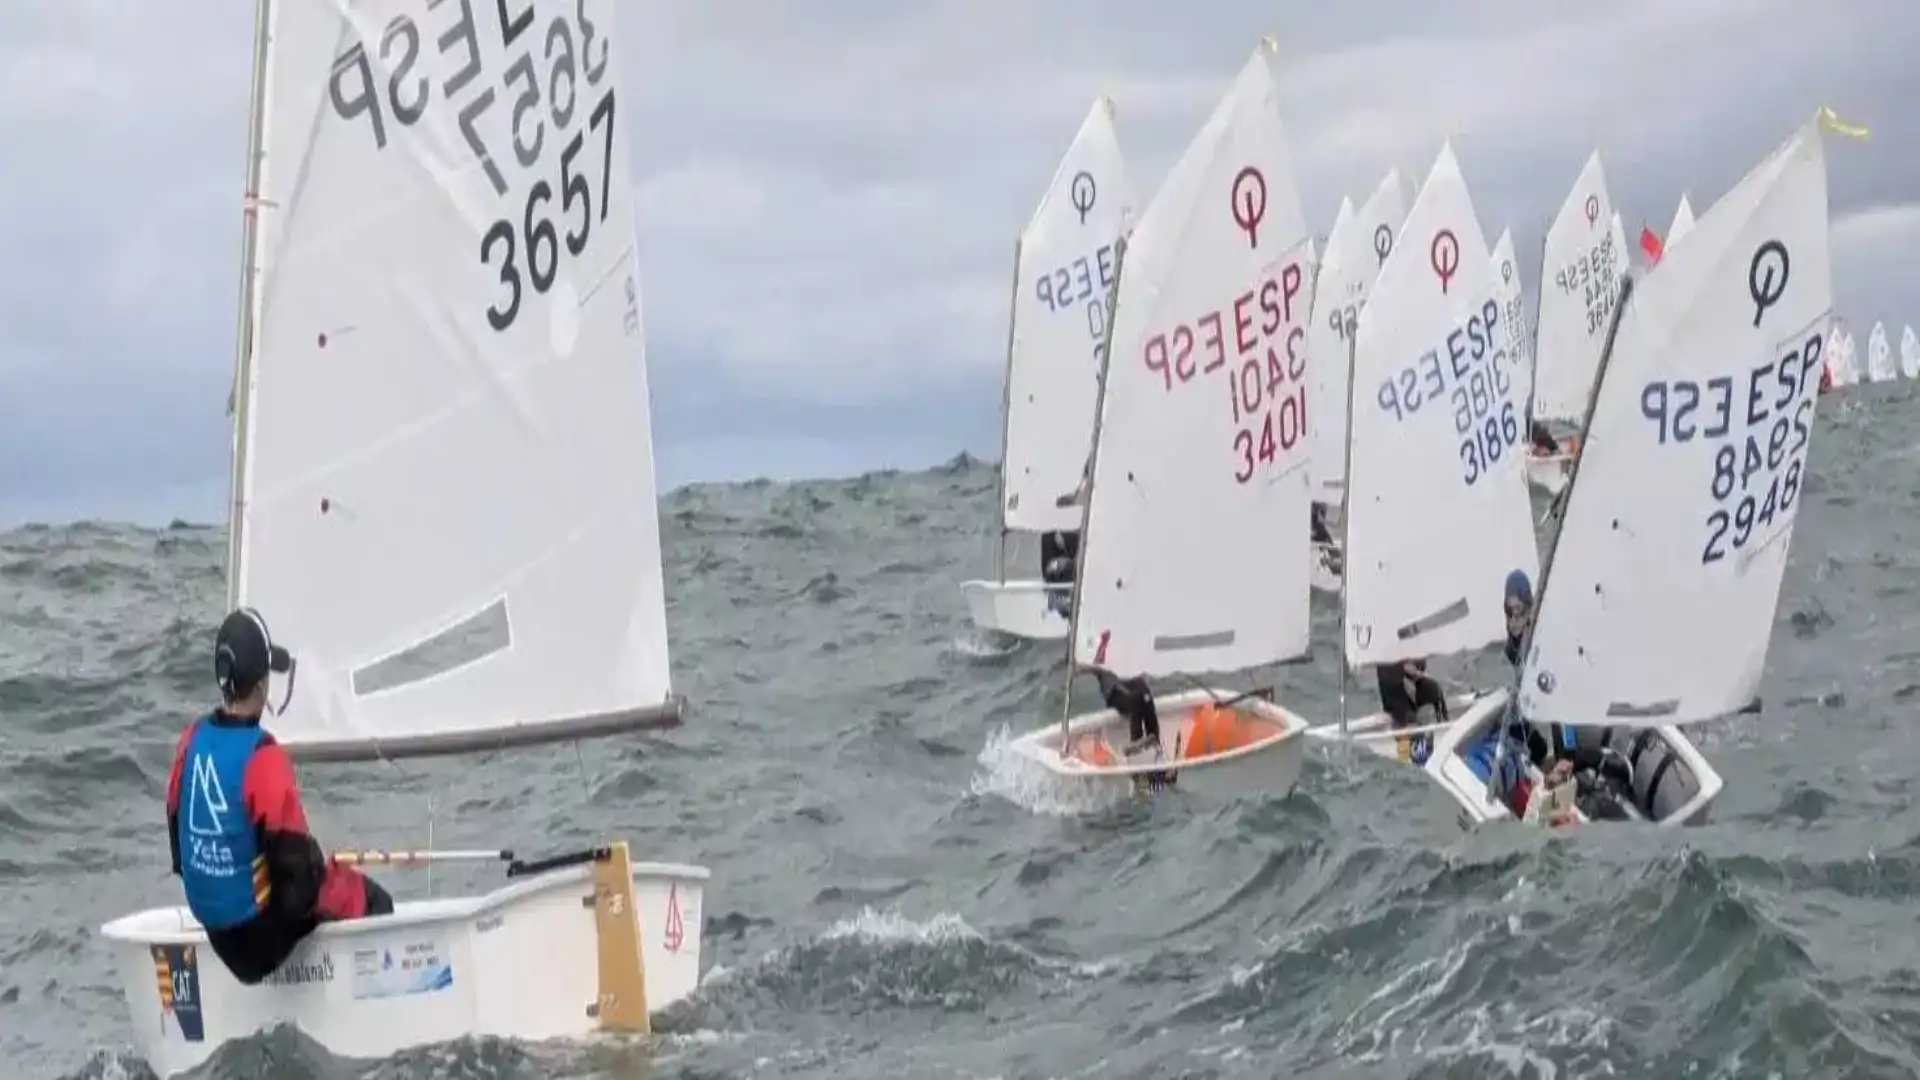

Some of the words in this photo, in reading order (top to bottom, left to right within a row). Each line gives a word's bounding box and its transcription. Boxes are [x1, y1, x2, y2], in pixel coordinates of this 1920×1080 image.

[480, 87, 615, 332] 3657
[1234, 262, 1302, 354] ESP
[1447, 298, 1498, 381] ESP
[1748, 334, 1822, 426] ESP
[1233, 385, 1307, 483] 3401
[1460, 401, 1517, 486] 3186
[1703, 459, 1801, 564] 2948
[172, 969, 191, 1002] CAT
